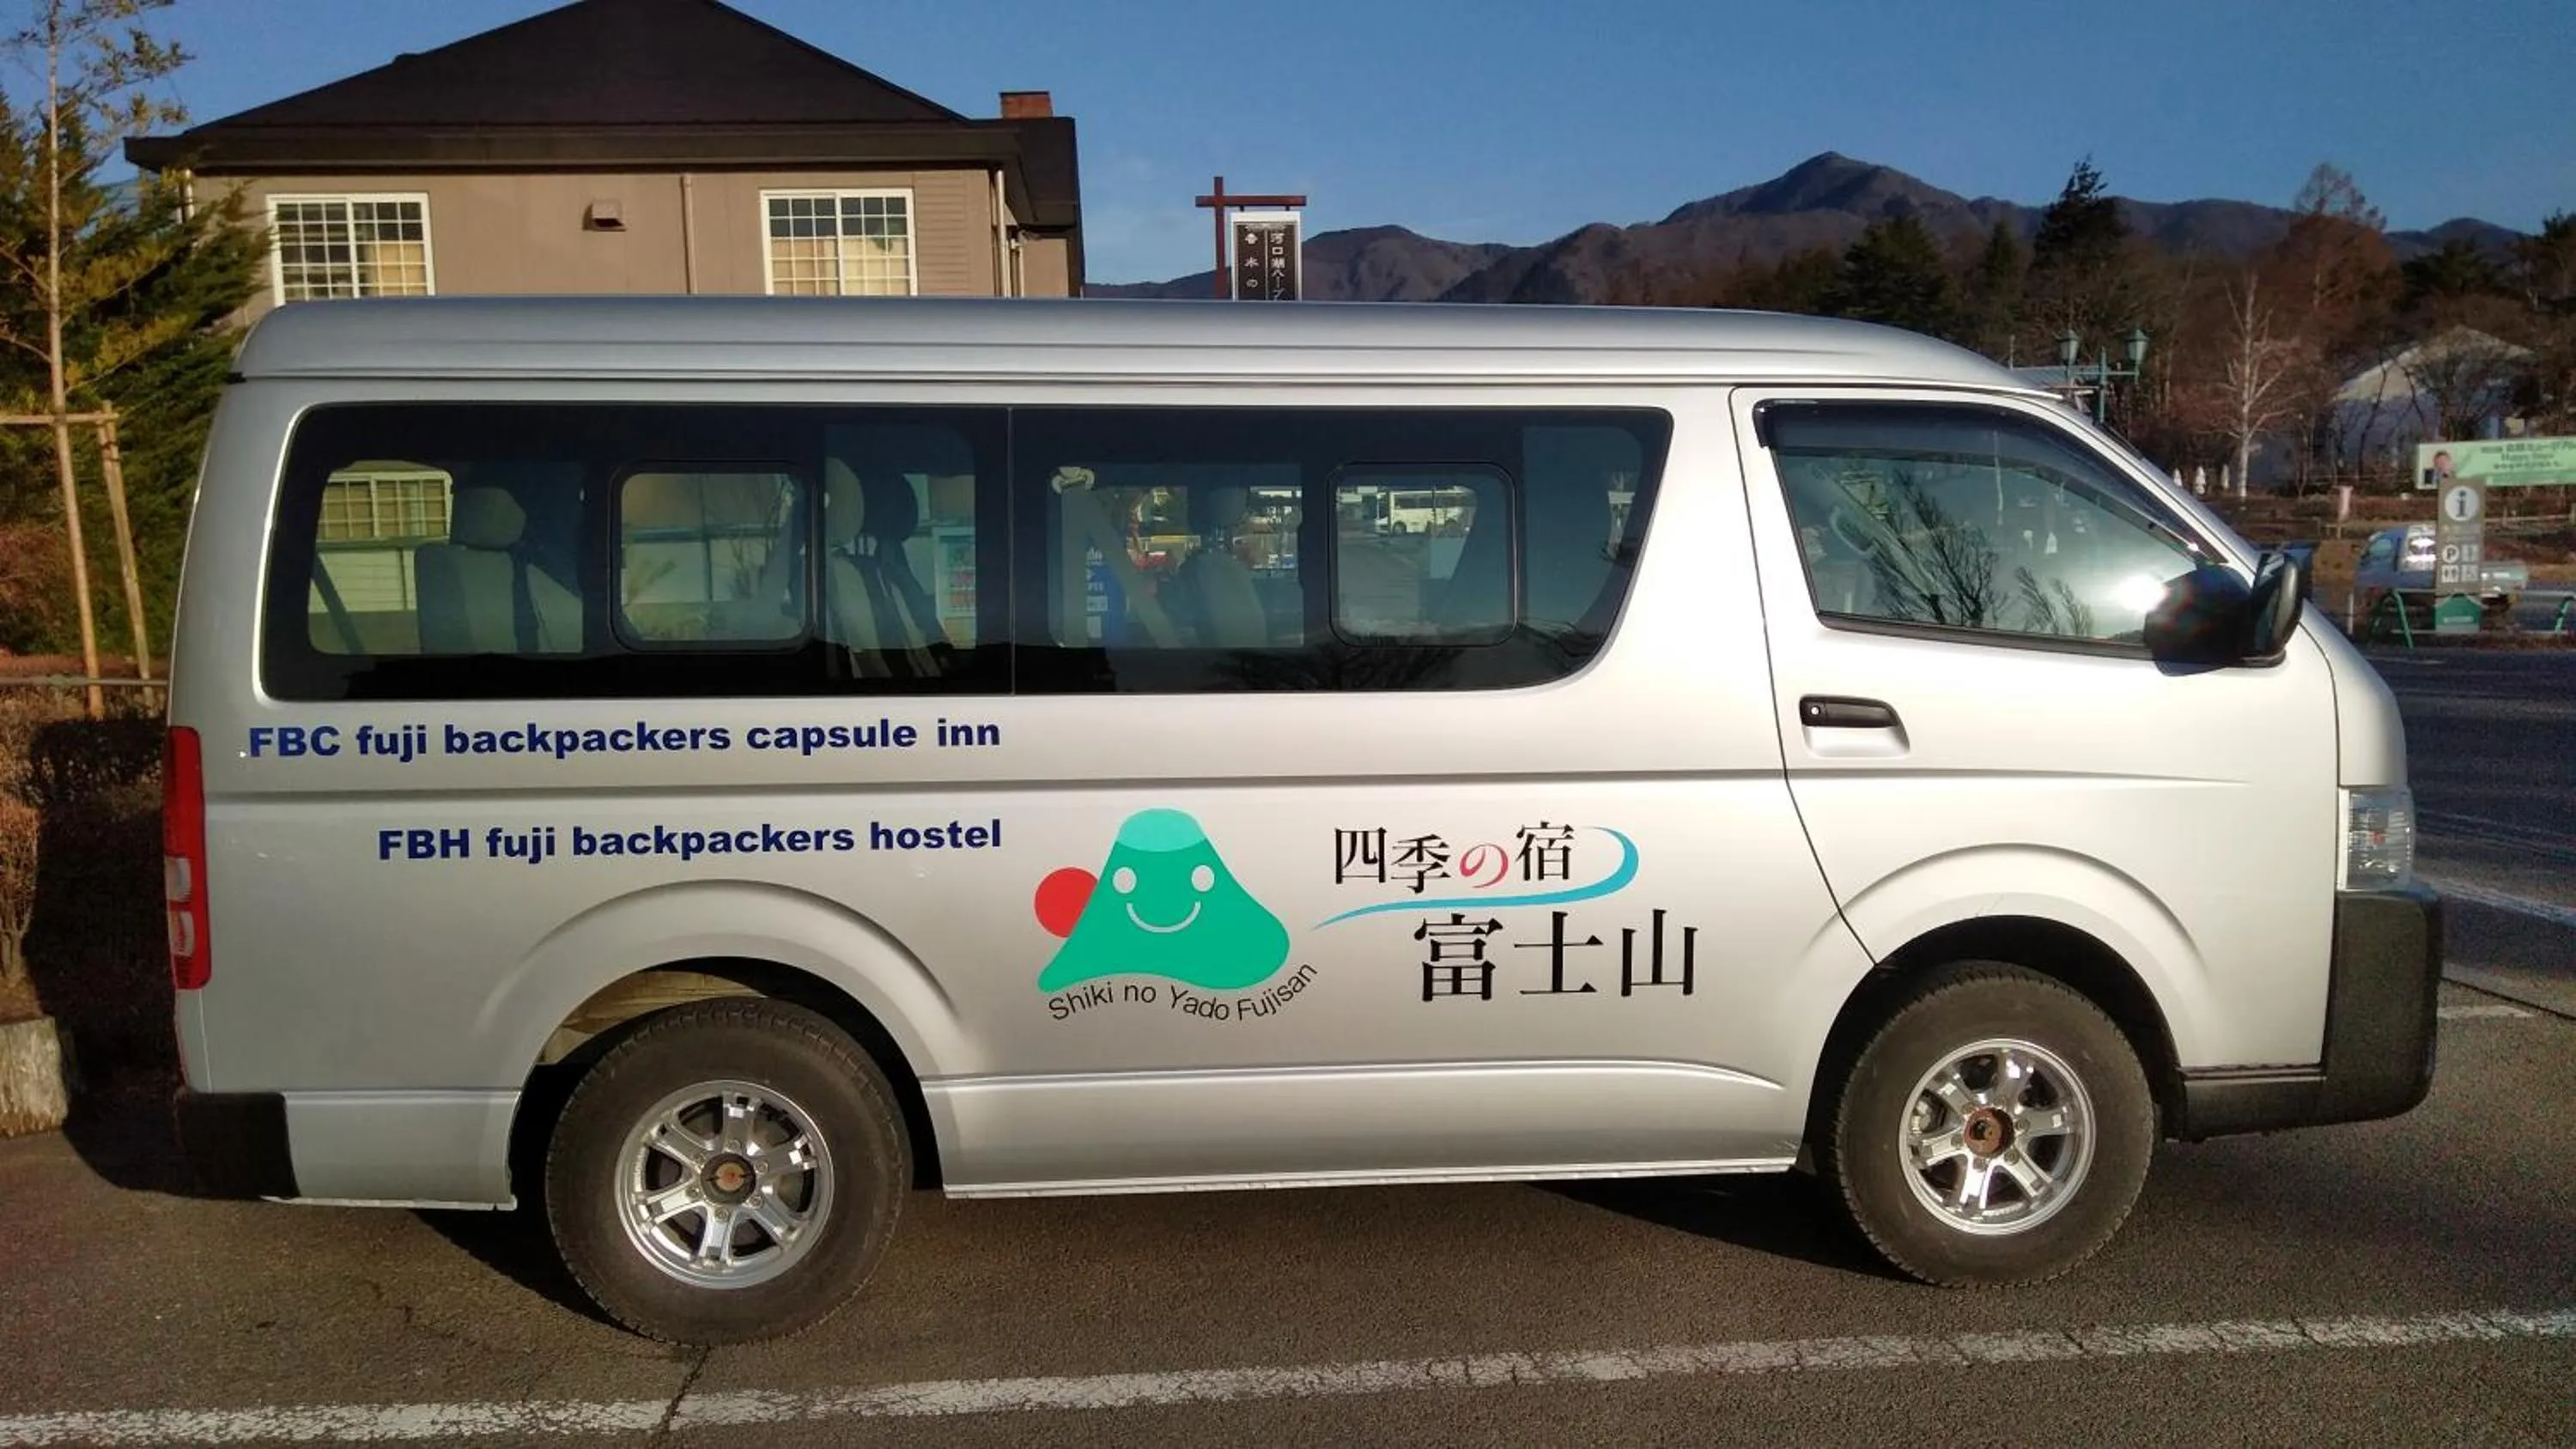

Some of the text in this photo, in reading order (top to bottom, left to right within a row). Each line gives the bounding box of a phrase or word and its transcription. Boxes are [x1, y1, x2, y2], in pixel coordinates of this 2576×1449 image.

[250, 718, 1000, 763] FBC fuji backpackers capsule inn
[379, 818, 1000, 864] FBH fuji backpackers hostel
[1334, 821, 1575, 894] 四季の宿
[1413, 908, 1698, 1003] 富士山
[1048, 962, 1318, 1021] Shiki no Yado Fujisan
